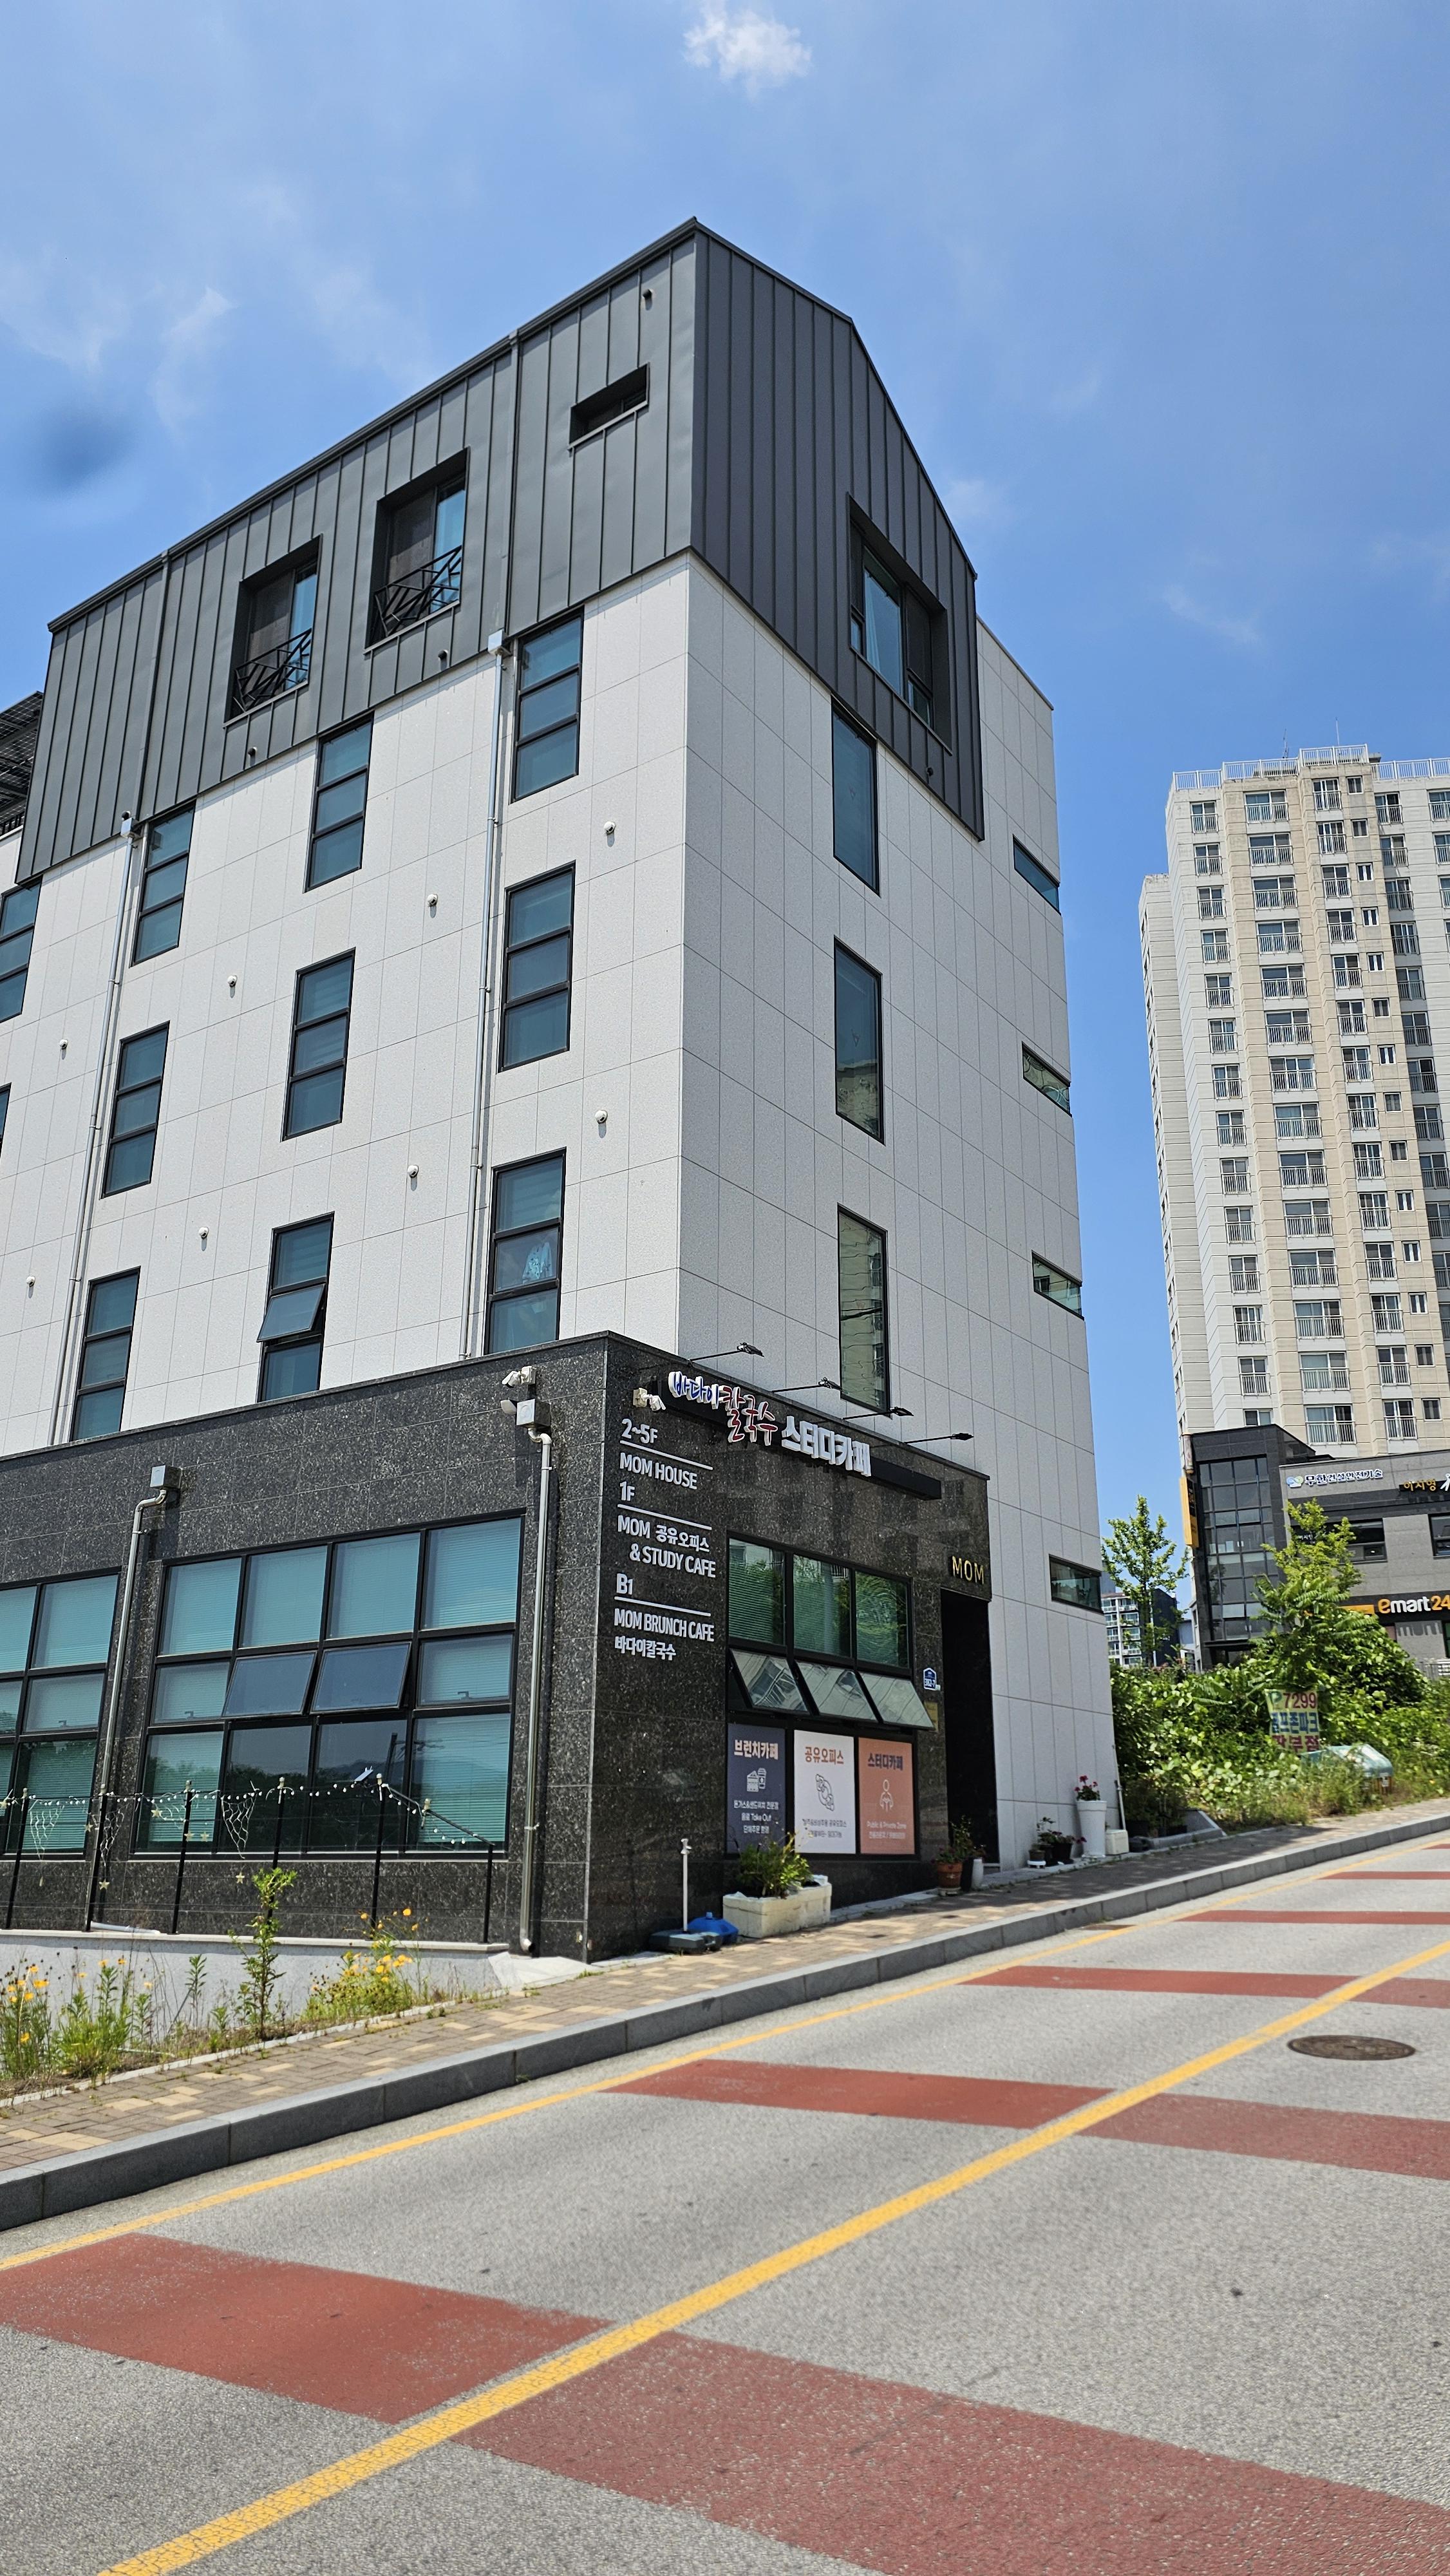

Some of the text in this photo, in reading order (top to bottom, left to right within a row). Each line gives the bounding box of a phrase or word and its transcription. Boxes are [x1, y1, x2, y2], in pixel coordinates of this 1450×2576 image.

[621, 1418, 658, 1444] 2~5F
[668, 1371, 871, 1477] 바다이칼국수 스터디카페
[619, 1452, 697, 1490] MOM HOUSE
[1304, 1468, 1383, 1486] 무한건설안전기술
[619, 1481, 635, 1501] 1F
[1404, 1479, 1436, 1492] 이지영
[617, 1515, 710, 1552] MOM 공유오피스
[629, 1543, 716, 1578] & STUDY CAFE
[952, 1555, 984, 1584] MOM
[616, 1573, 633, 1595] B1
[1378, 1595, 1450, 1614] emart24
[614, 1608, 714, 1642] MOM BRUNCH CAFE
[614, 1635, 676, 1660] 바다이칼국수
[1283, 1691, 1317, 1709] 7299
[734, 1739, 778, 1760] 브런치카페
[805, 1747, 844, 1765] 공유오피스
[867, 1753, 903, 1771] 스터디카페
